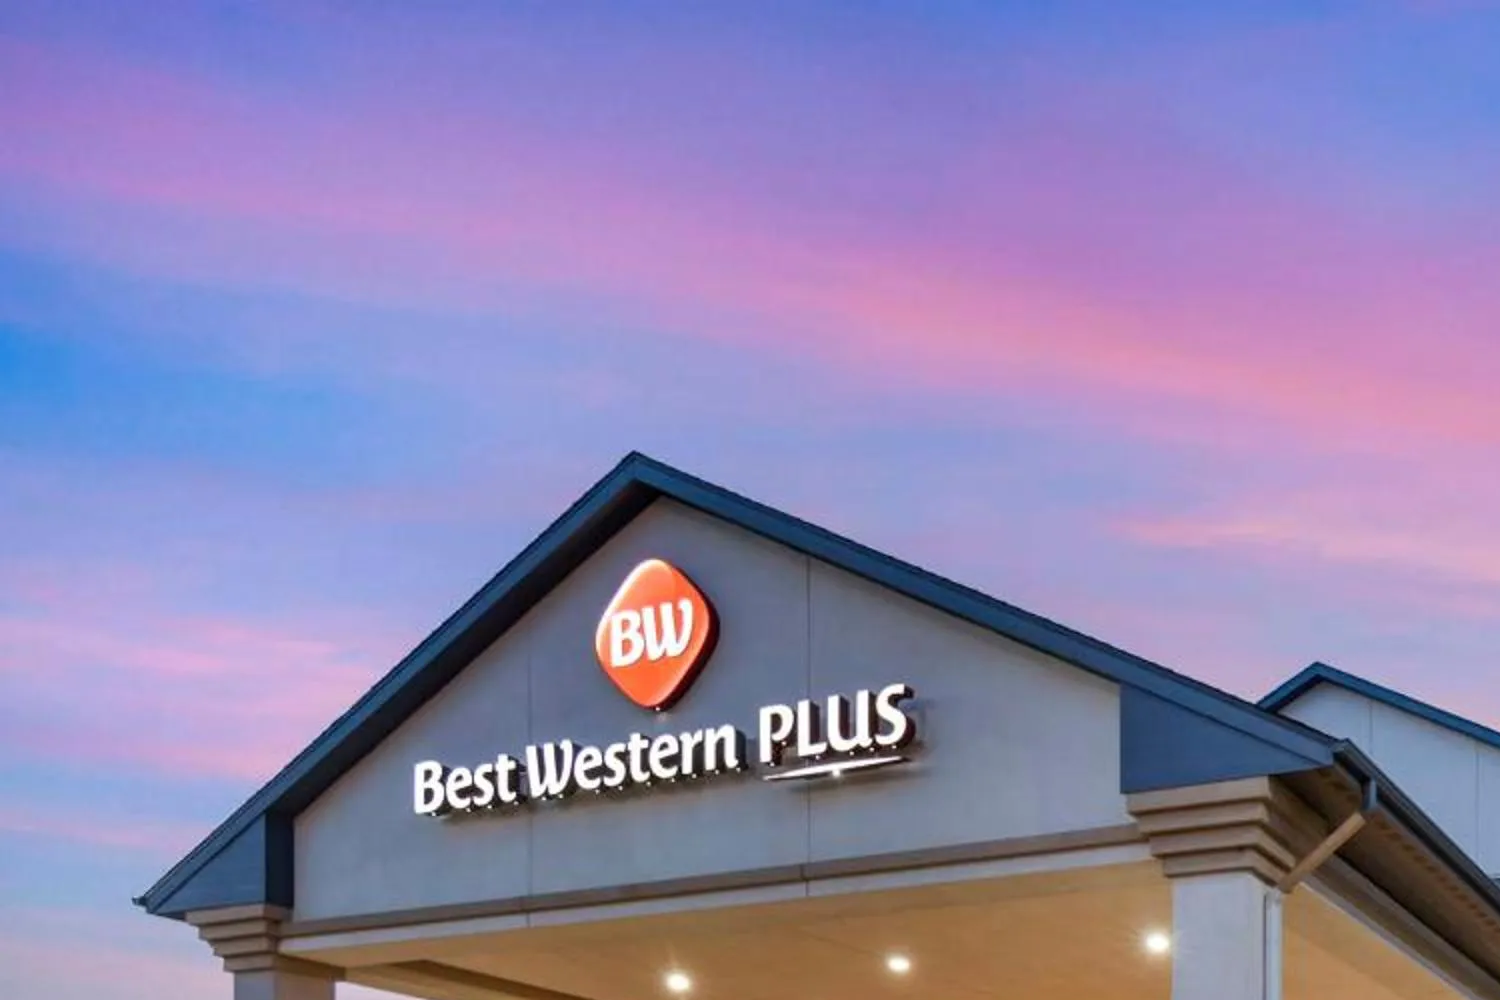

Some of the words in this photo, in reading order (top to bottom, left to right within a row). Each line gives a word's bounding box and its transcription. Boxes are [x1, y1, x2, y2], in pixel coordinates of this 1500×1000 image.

[609, 599, 693, 668] BW
[414, 753, 517, 814] Best
[525, 724, 739, 798] Western
[759, 683, 907, 763] PLUS
